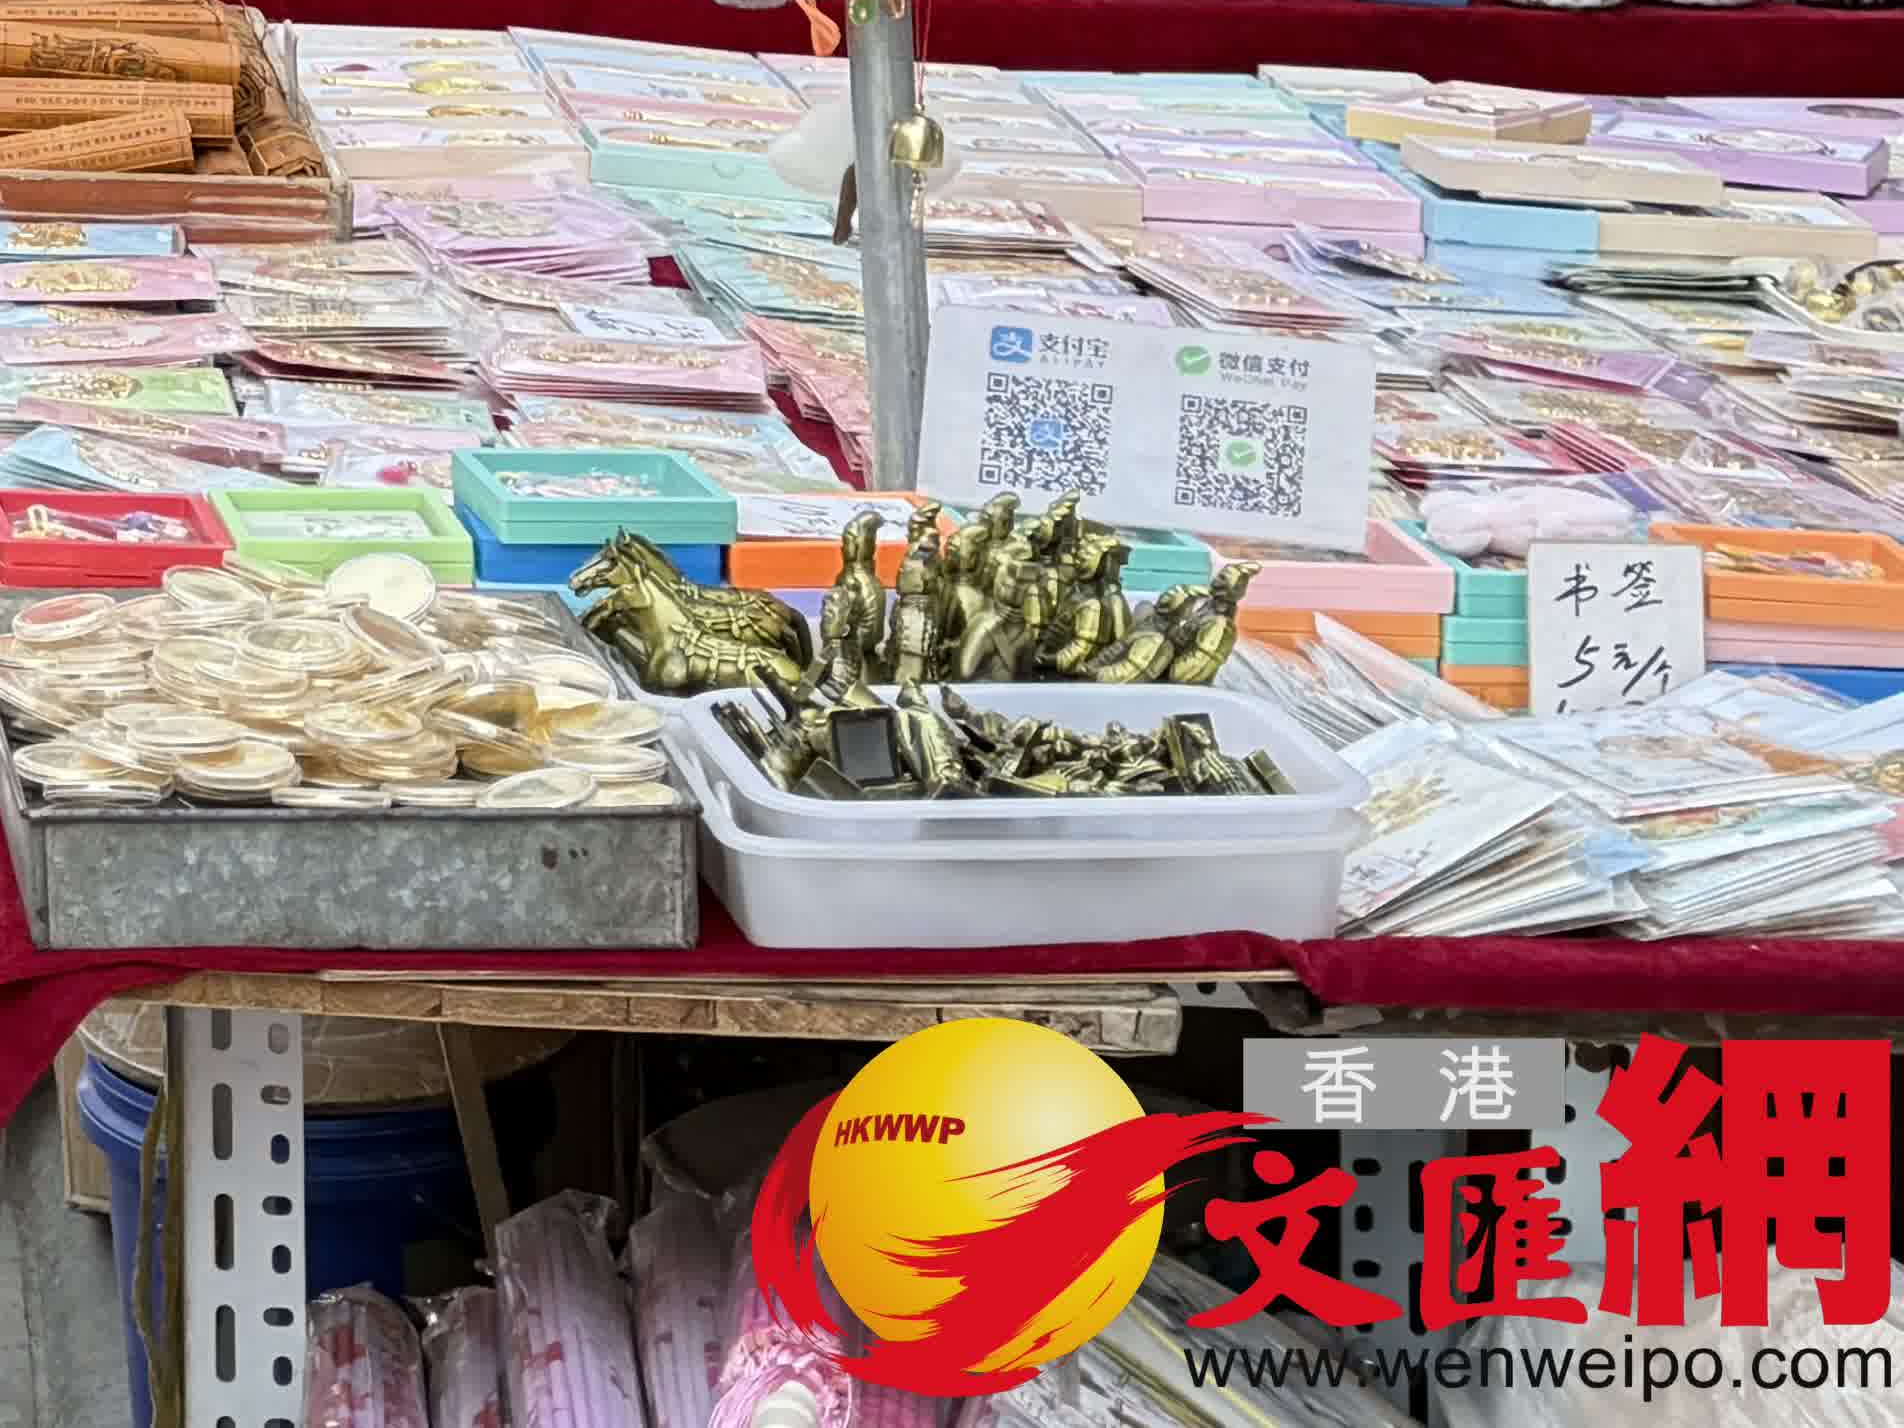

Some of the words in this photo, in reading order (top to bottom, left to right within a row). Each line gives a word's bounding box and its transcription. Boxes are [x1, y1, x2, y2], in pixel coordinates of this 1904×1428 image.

[1039, 331, 1110, 360] 支付宝
[1219, 351, 1310, 378] 微信支付
[1553, 560, 1664, 617] 书签
